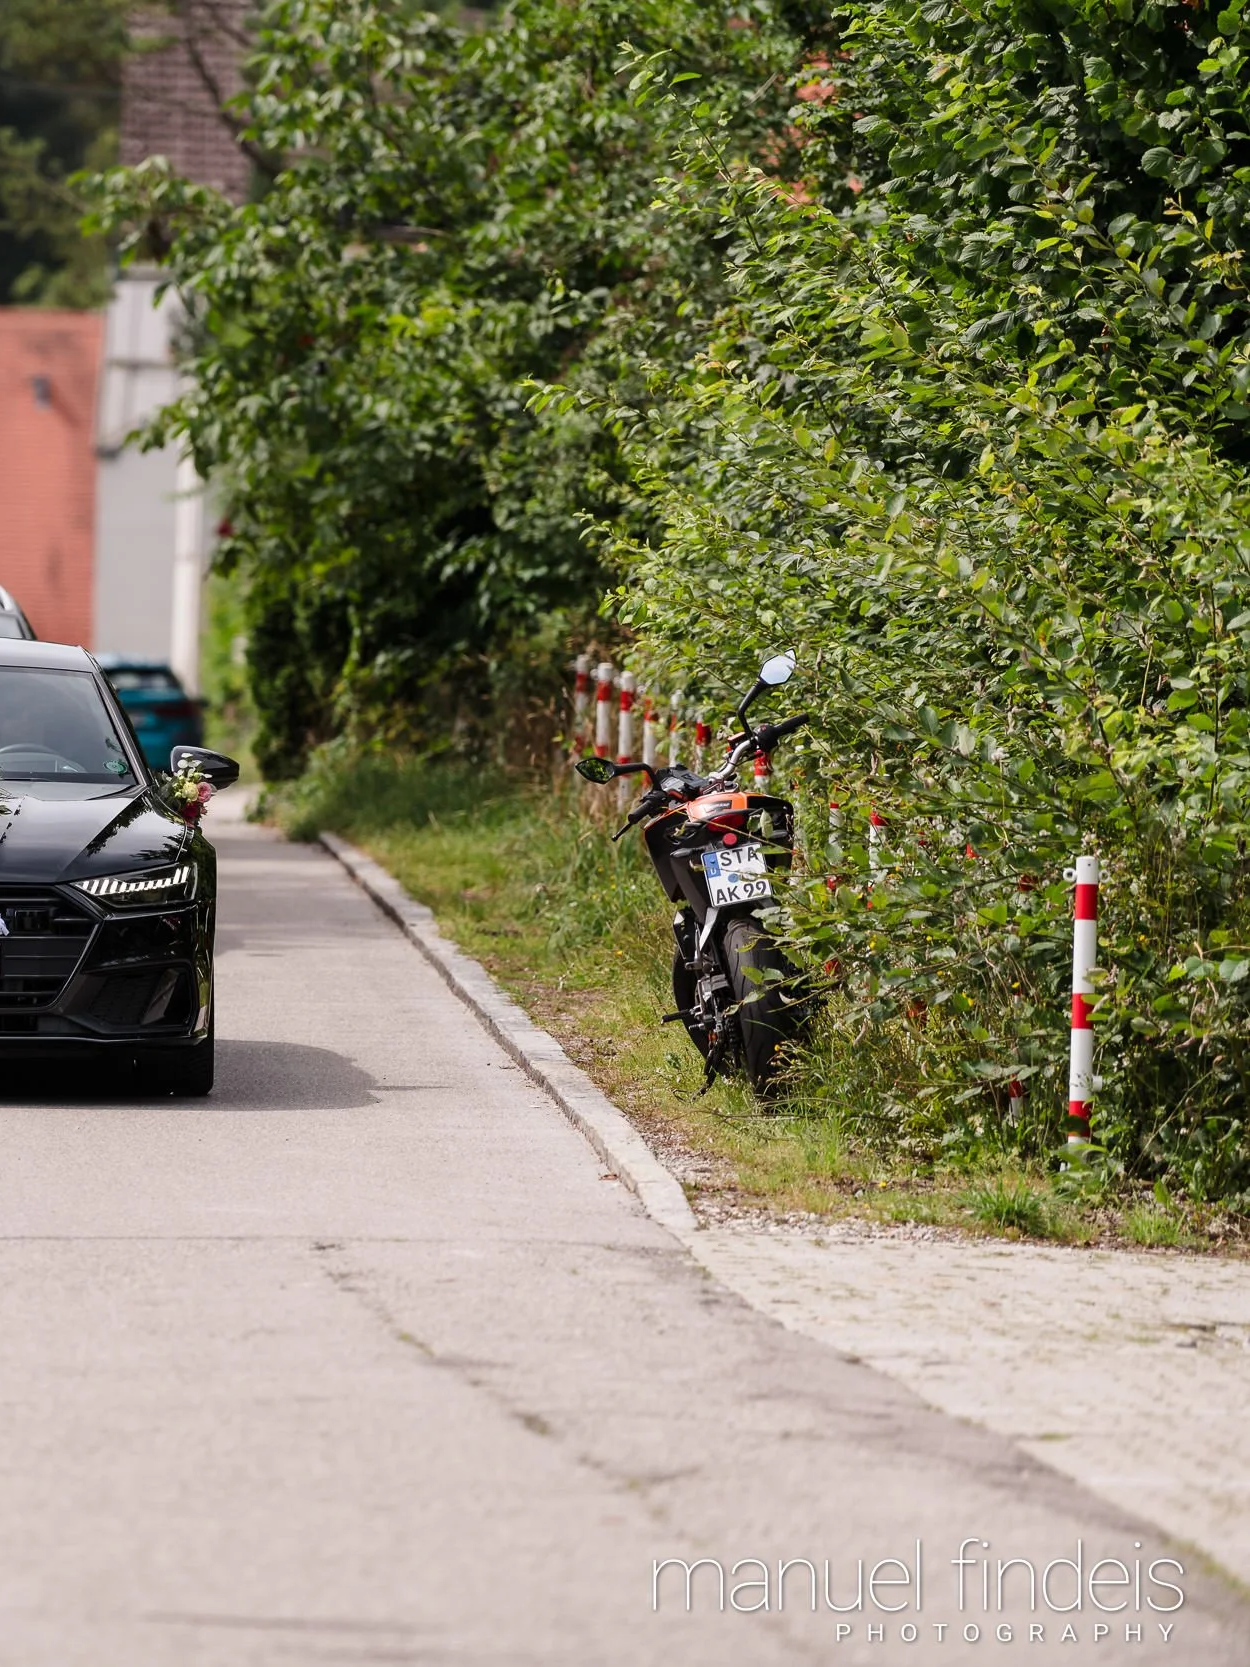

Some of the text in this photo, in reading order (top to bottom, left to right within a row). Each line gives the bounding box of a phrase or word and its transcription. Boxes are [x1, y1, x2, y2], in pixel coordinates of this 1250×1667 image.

[720, 846, 758, 867] STA
[716, 880, 767, 905] AK 99
